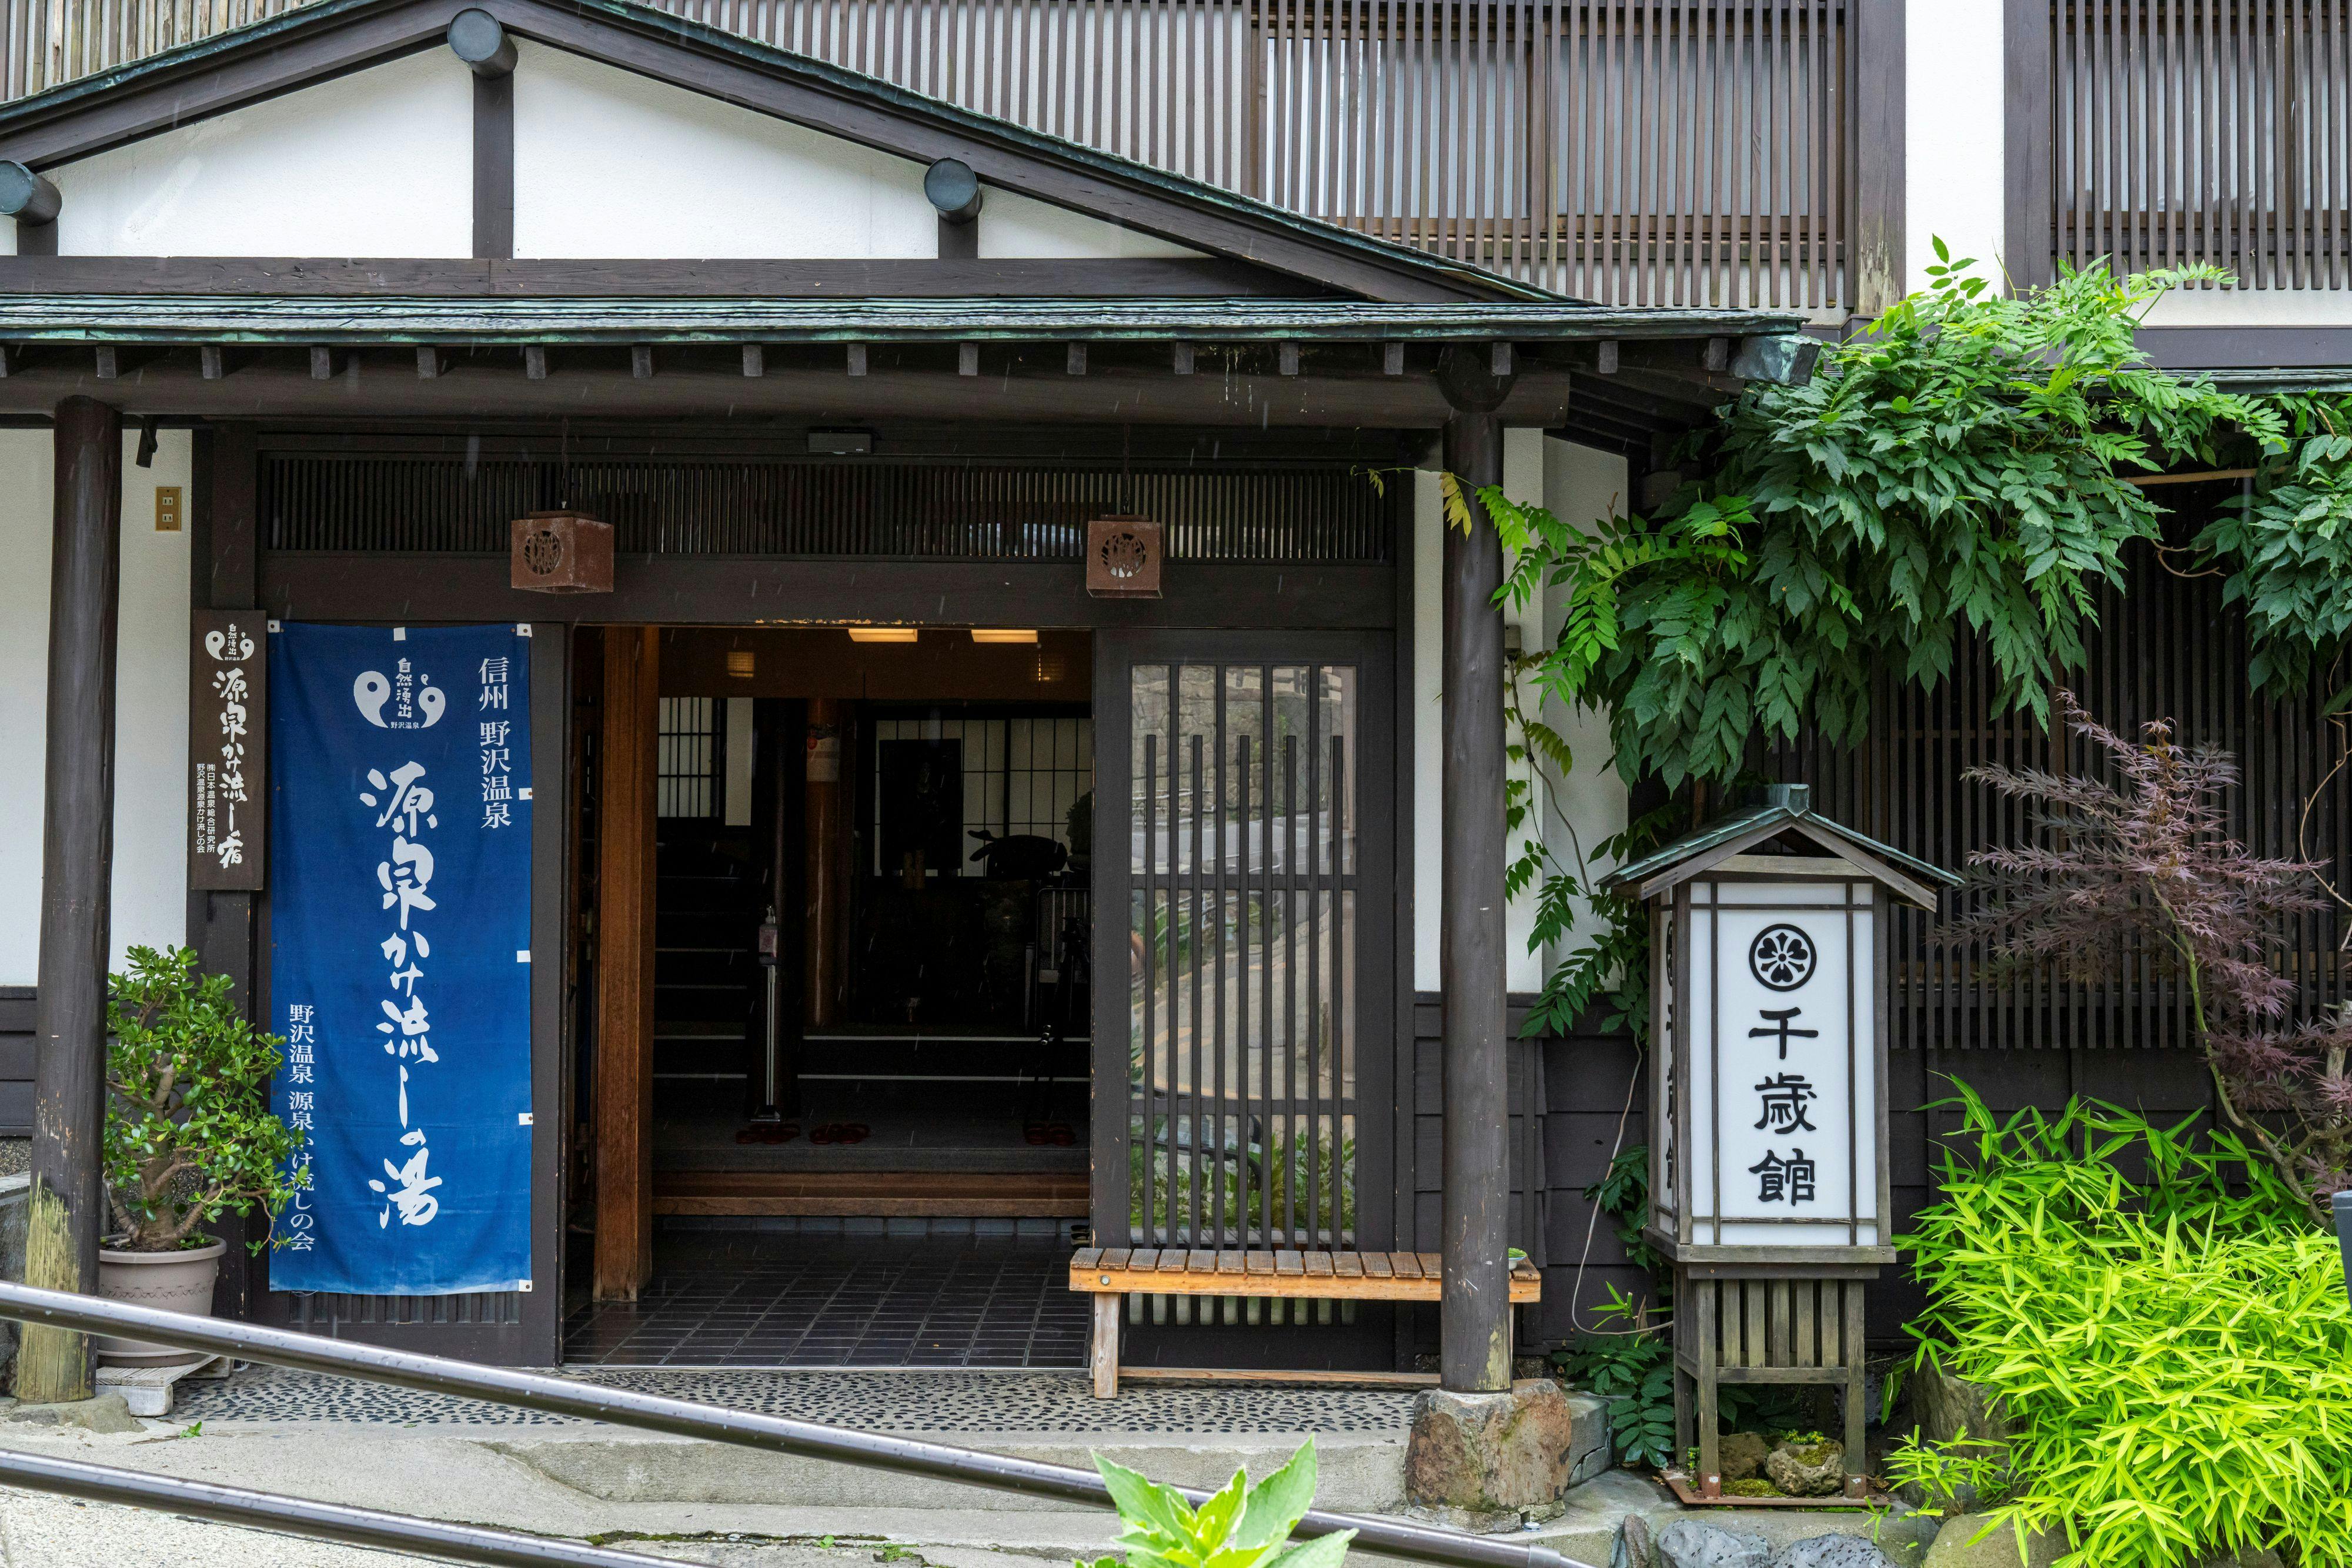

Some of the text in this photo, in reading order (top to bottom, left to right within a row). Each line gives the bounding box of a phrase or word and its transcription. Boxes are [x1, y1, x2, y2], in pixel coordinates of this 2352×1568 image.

[228, 624, 237, 655] 自然湧出
[396, 657, 412, 718] 自然湧出
[479, 657, 512, 828] 信州 野沢温泉
[196, 764, 205, 853] 野沢温泉源泉かけ流しの会
[360, 761, 442, 1229] 源泉かけ流しの湯
[289, 1004, 315, 1084] 野沢温泉
[1748, 1007, 1819, 1206] 千歳館
